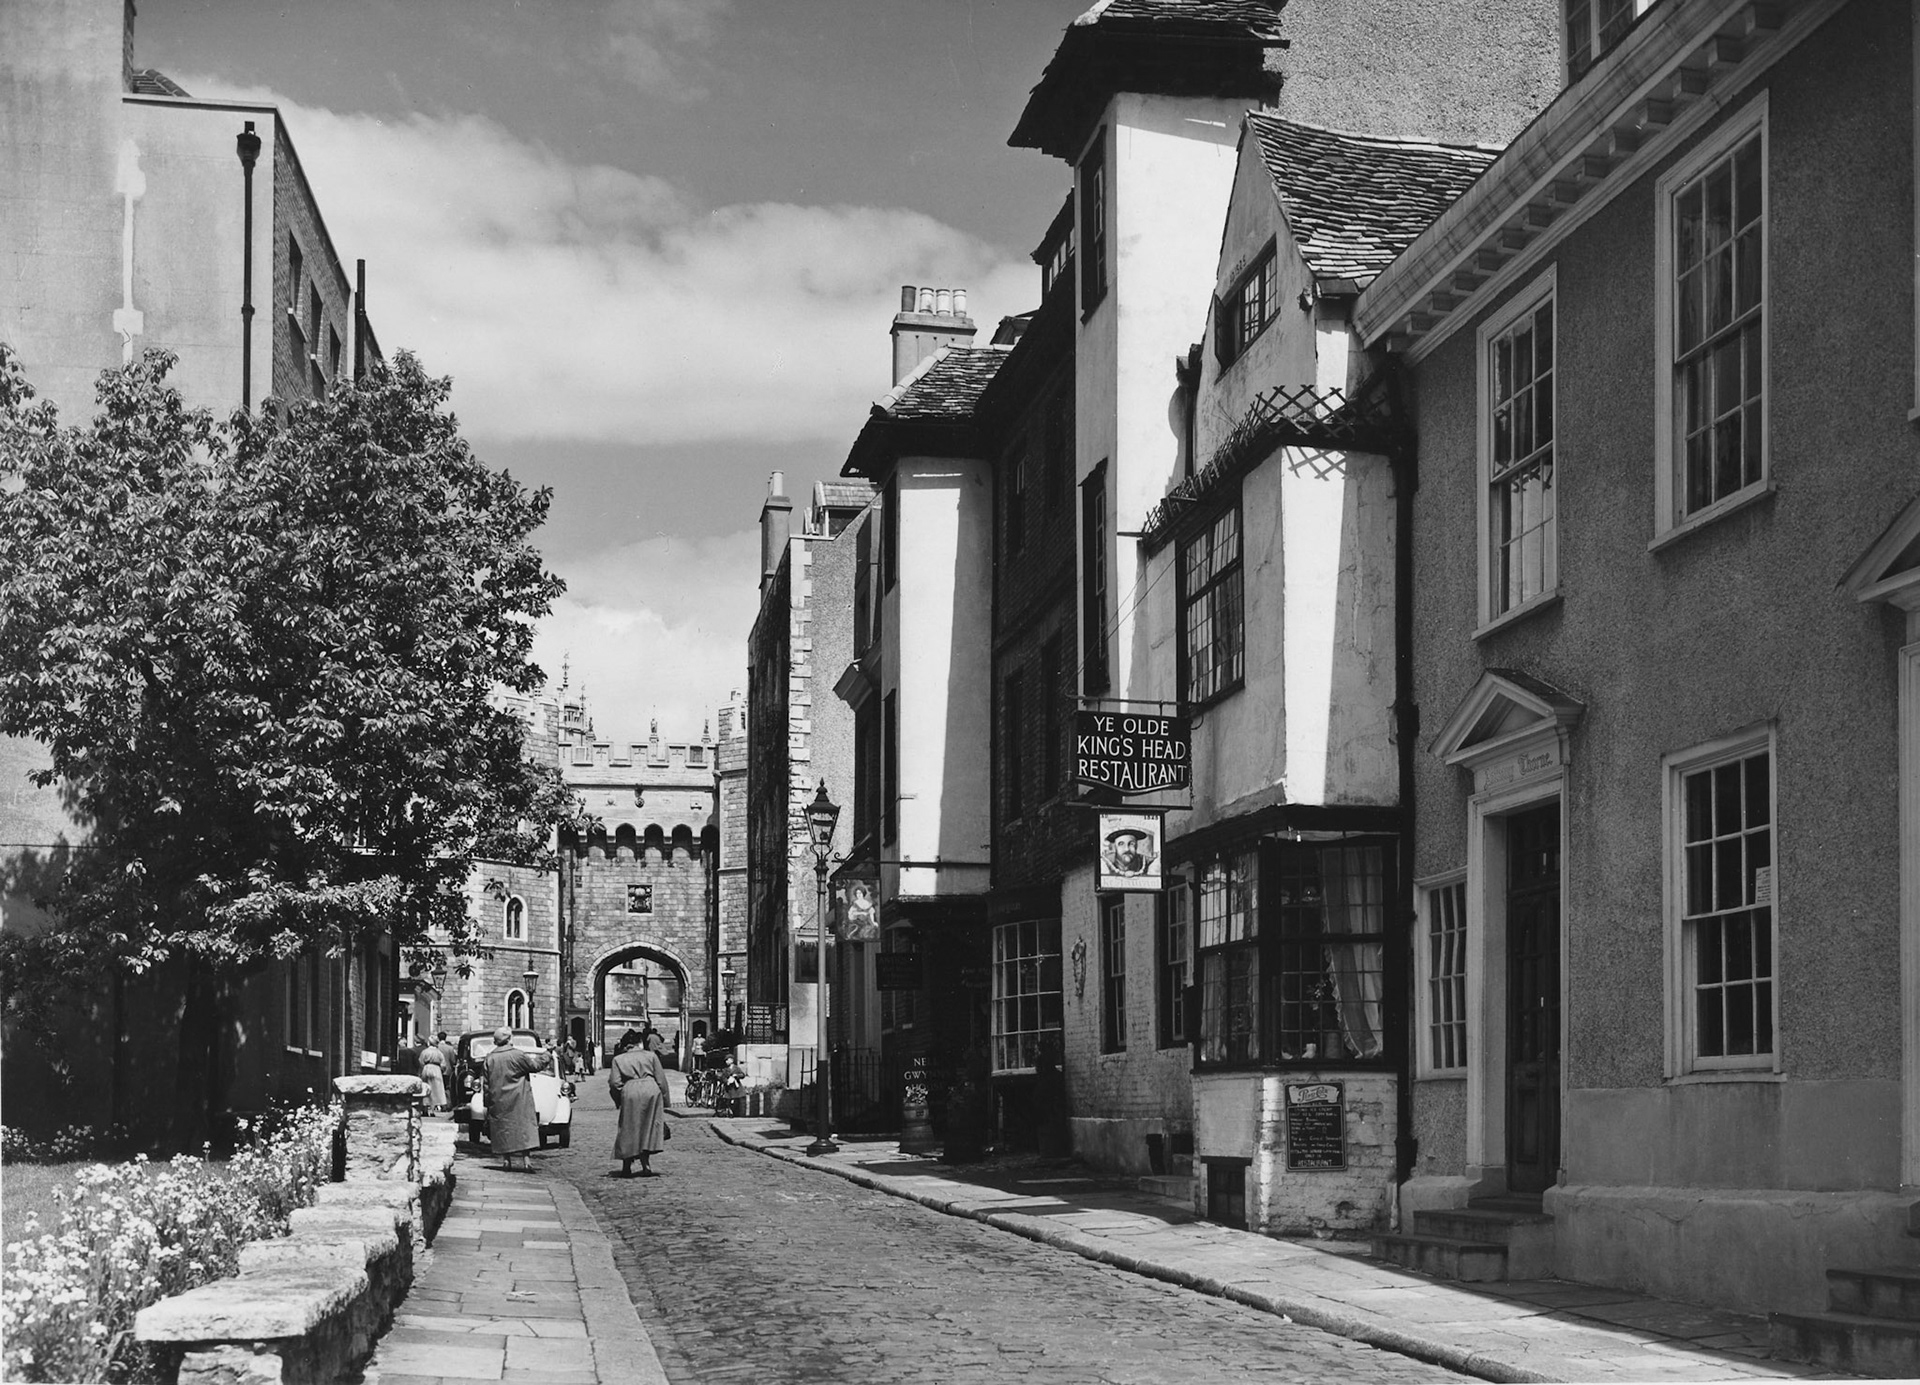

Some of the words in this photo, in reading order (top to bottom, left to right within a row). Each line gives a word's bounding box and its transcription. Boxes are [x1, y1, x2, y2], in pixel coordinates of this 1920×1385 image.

[1094, 716, 1115, 732] YE
[1123, 718, 1169, 736] OLDE
[1077, 735, 1134, 757] KING'S
[1142, 739, 1186, 760] HEAD
[1078, 759, 1187, 790] RESTAURANT
